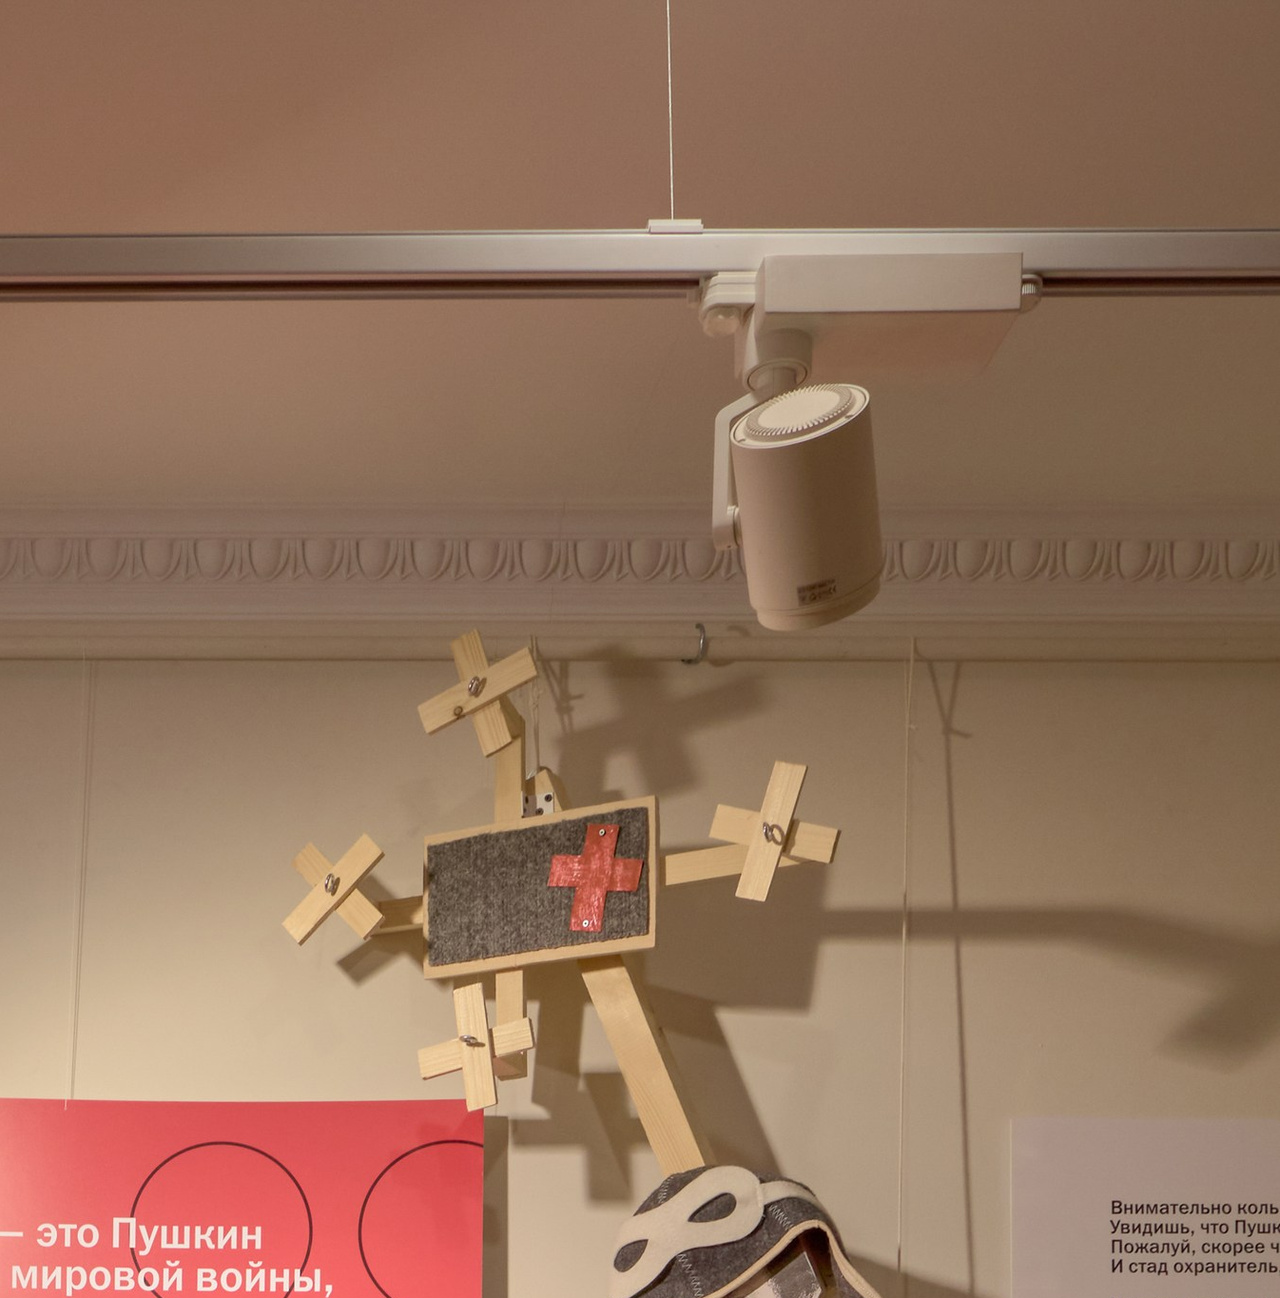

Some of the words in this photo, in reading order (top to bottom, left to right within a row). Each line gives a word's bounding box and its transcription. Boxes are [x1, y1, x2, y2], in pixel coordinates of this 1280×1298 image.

[1111, 1200, 1232, 1215] Внимательно
[1237, 1203, 1279, 1215] коль
[37, 1223, 99, 1248] это
[112, 1217, 262, 1256] Пушкин
[1109, 1219, 1195, 1237] Увидишь,
[1200, 1223, 1229, 1234] что
[1111, 1239, 1196, 1257] Пожалуй,
[1201, 1242, 1265, 1257] скорее
[11, 1260, 184, 1297] мировой
[196, 1261, 333, 1298] войны,
